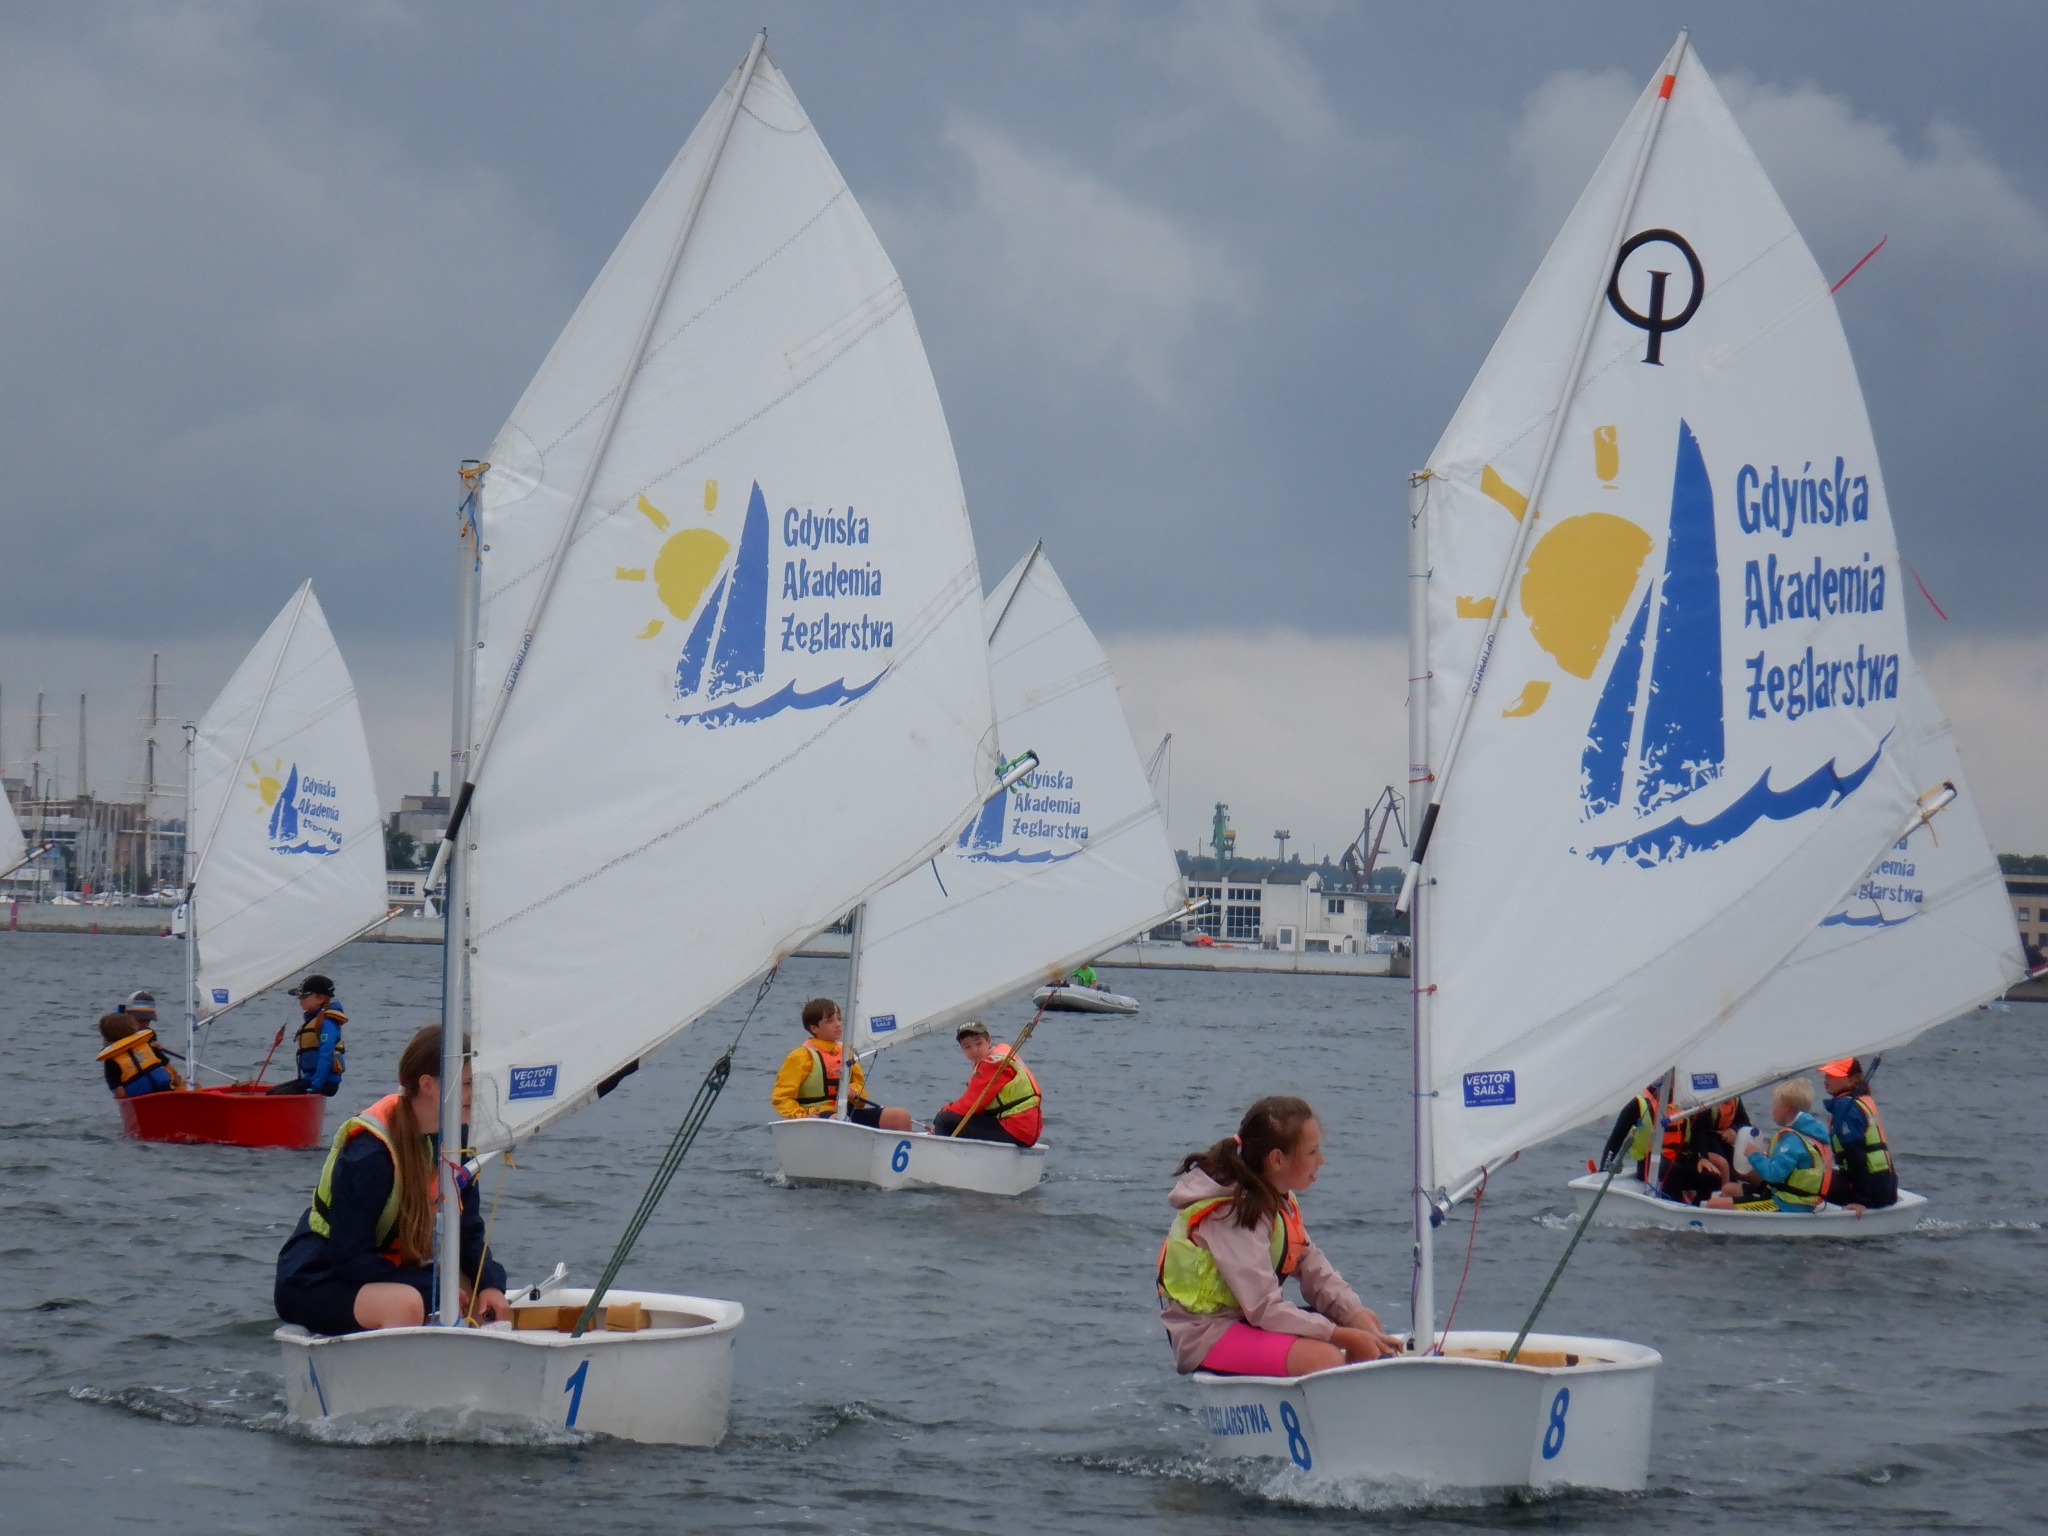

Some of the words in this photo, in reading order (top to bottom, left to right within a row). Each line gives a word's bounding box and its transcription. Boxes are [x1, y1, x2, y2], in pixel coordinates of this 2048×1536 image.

[1736, 456, 1869, 537] Gdyńska
[783, 506, 869, 550] Gdyńska
[782, 558, 882, 601] Akademia
[1745, 552, 1885, 629] Akademia
[298, 798, 340, 821] Akademia
[1014, 792, 1081, 815] Akademia
[514, 1068, 553, 1081] VECTOR
[518, 1078, 546, 1090] SAILS
[1466, 1072, 1511, 1086] VECTOR
[1473, 1084, 1505, 1096] SAILS
[892, 1140, 912, 1173] 6
[563, 1359, 590, 1428] 1
[1279, 1400, 1312, 1471] 8
[1542, 1387, 1570, 1460] 8
